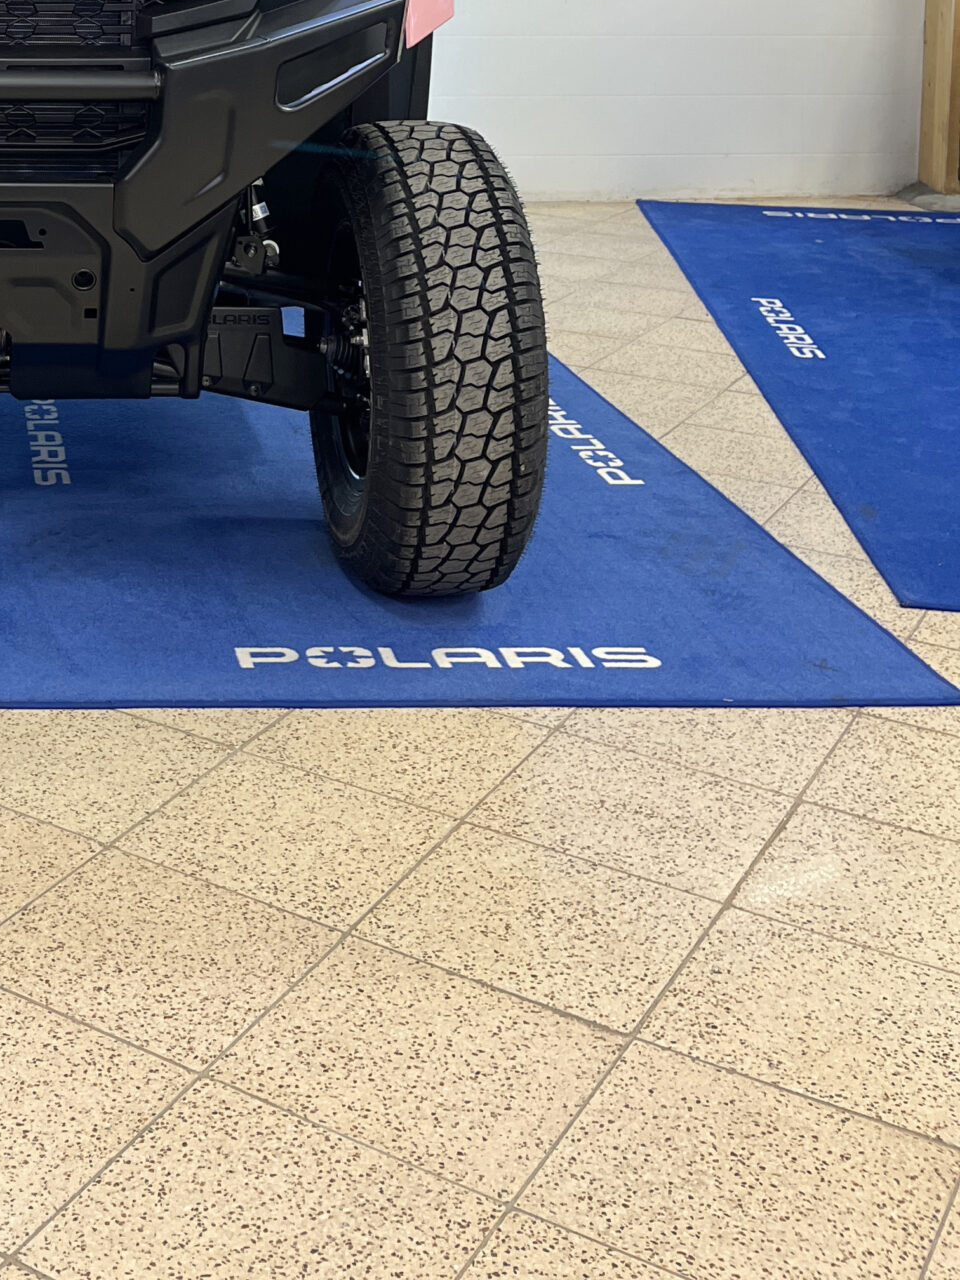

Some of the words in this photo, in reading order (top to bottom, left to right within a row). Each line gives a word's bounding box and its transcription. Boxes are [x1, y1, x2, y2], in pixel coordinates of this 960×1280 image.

[751, 297, 826, 358] POLARIS
[24, 399, 71, 486] OLARIS
[234, 647, 662, 669] POLARIS
